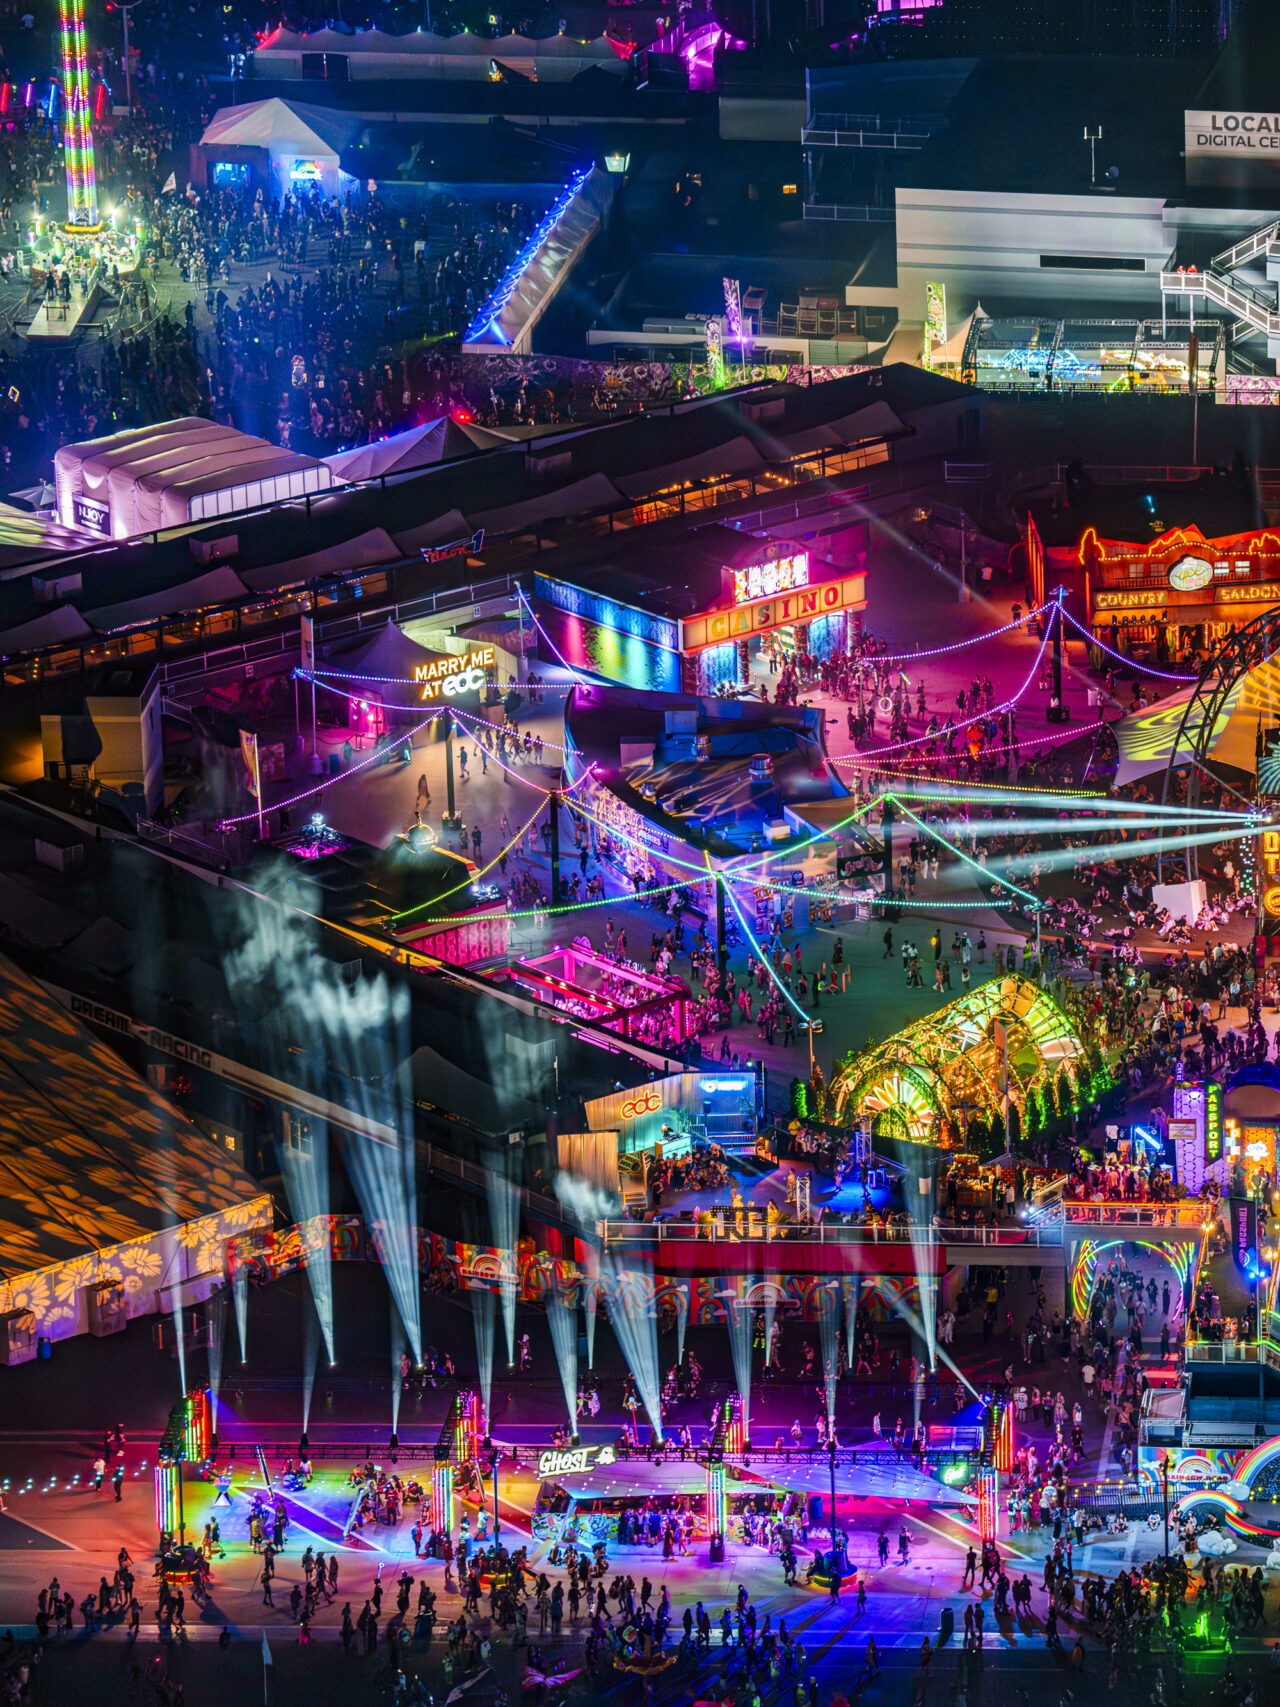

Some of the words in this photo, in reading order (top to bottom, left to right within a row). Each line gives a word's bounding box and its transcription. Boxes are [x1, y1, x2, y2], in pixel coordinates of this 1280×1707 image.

[1197, 134, 1256, 148] DIGITAL
[710, 586, 839, 638] CASINO
[1096, 592, 1165, 607] COUNTRY
[414, 655, 468, 682] MARRY
[471, 647, 494, 668] ME
[422, 680, 442, 700] AT
[442, 664, 485, 697] edc
[71, 995, 129, 1034] DREAM
[150, 1029, 212, 1070] RACING
[620, 1090, 663, 1120] edc
[1207, 1085, 1219, 1159] PASSPORT
[1225, 1118, 1241, 1164] MOTL
[539, 1446, 600, 1478] GHOST
